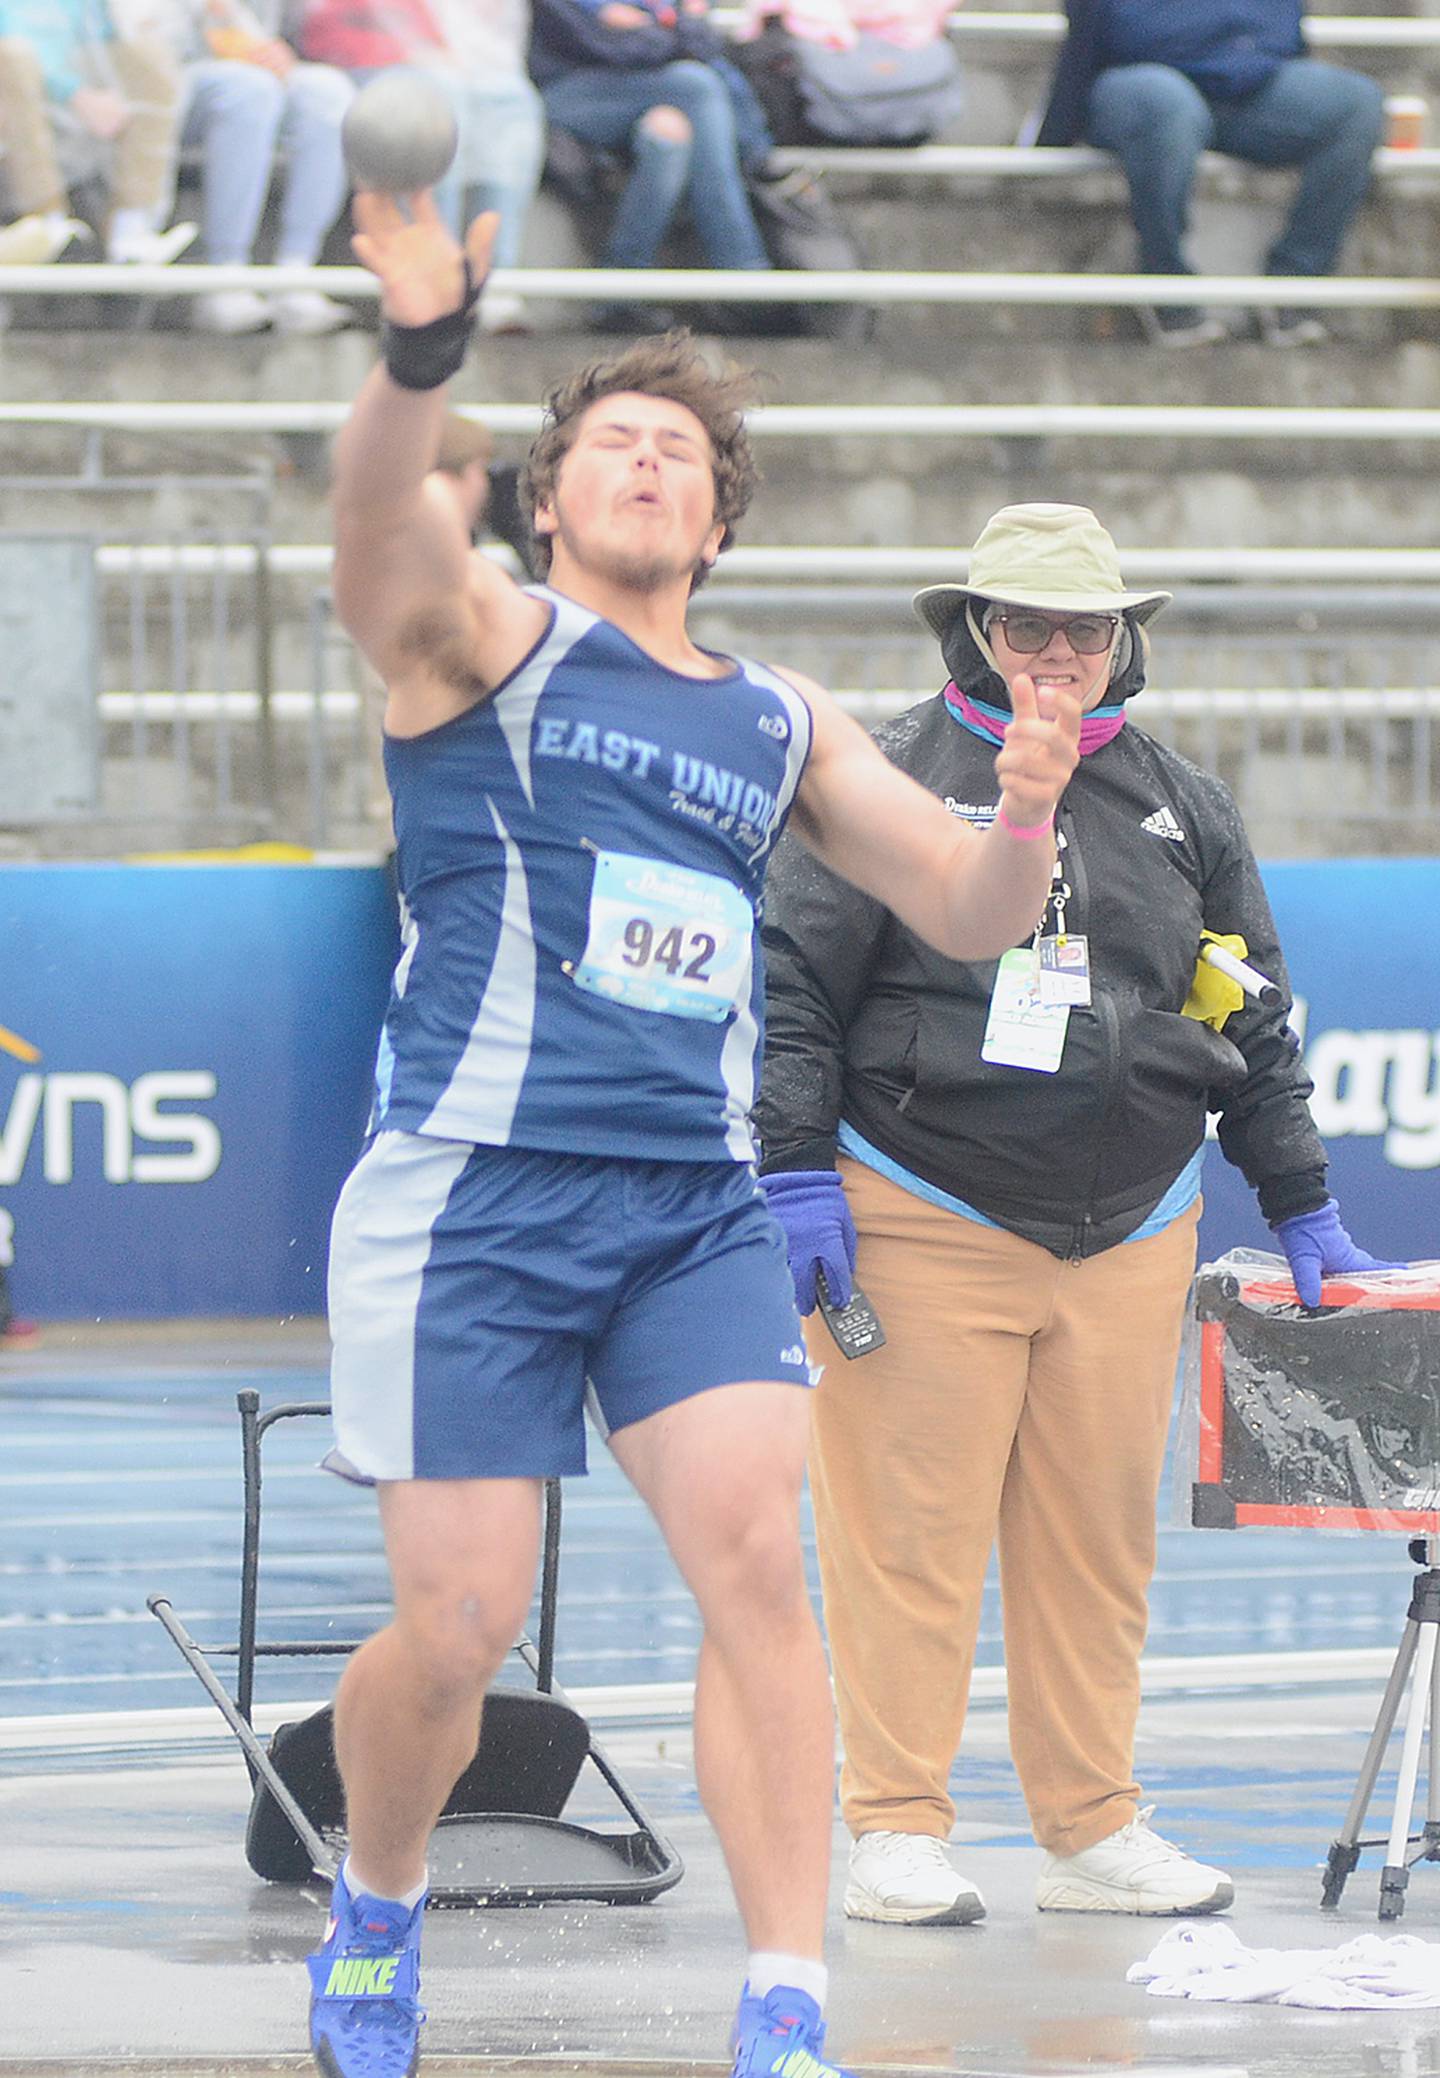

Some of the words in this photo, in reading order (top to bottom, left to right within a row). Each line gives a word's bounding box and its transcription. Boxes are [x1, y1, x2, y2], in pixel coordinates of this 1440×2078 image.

[534, 718, 661, 779] EAST
[672, 751, 777, 834] UNION
[1140, 818, 1186, 841] adidas
[621, 917, 717, 983] 942
[324, 1958, 399, 1996] NIKE
